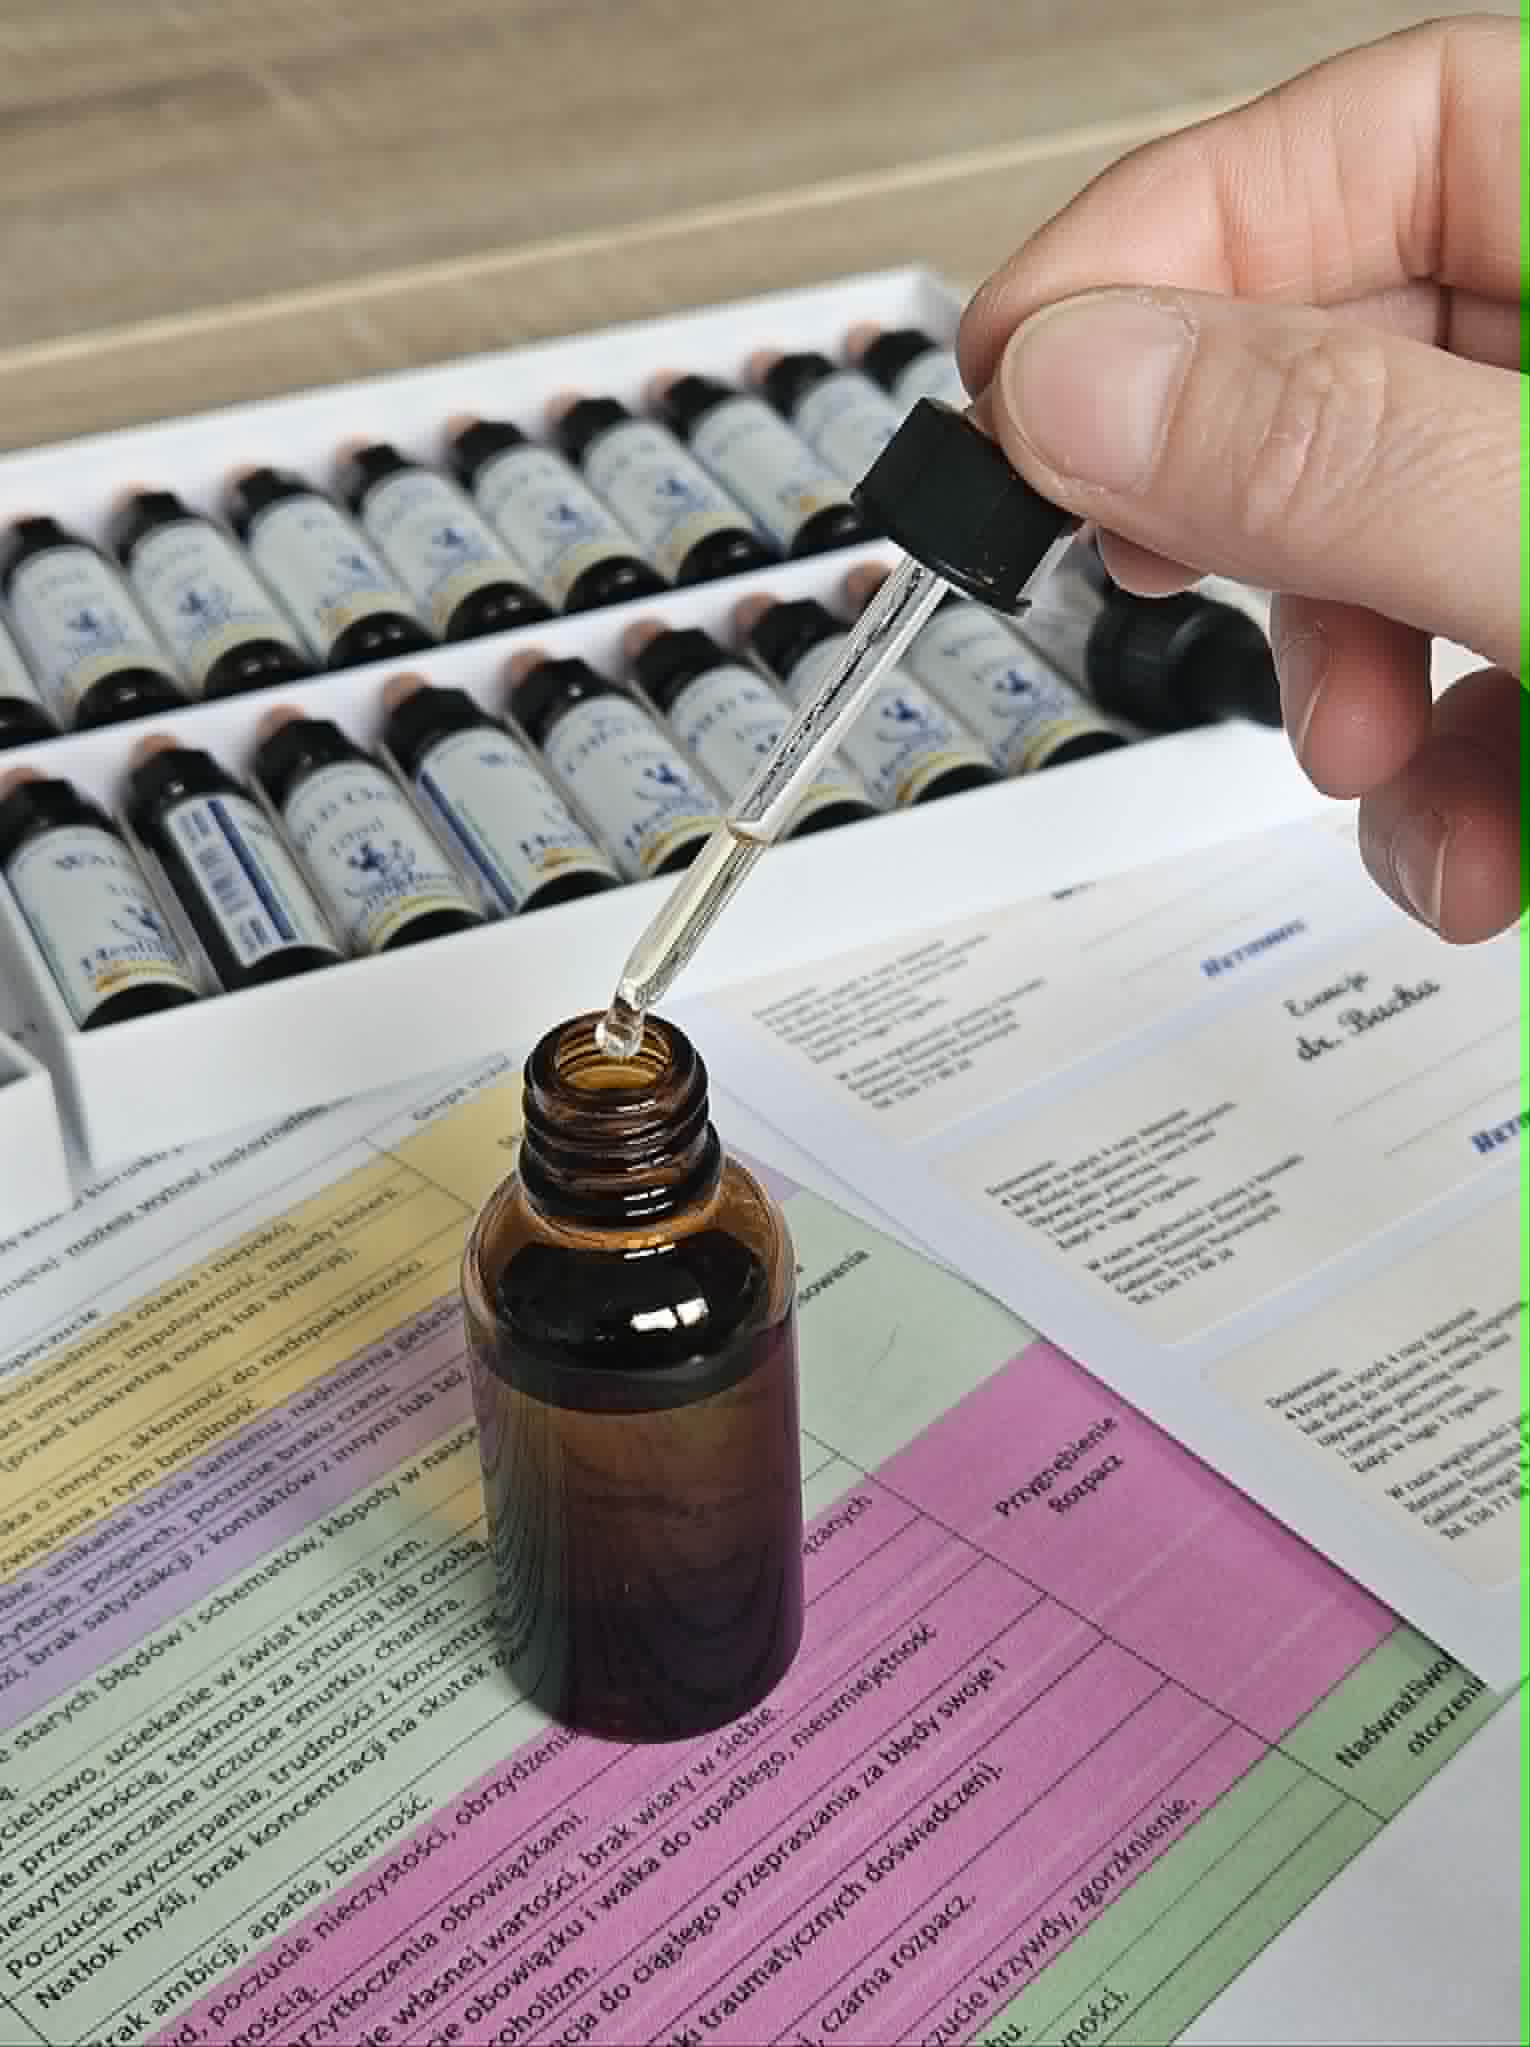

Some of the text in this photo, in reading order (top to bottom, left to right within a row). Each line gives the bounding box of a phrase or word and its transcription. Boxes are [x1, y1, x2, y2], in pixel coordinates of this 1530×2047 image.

[995, 1418, 1116, 1517] Przygnębienie
[1048, 1455, 1123, 1513] Rozpacz
[14, 1691, 98, 1750] starych
[96, 1630, 182, 1691] błędów
[182, 1620, 197, 1633] i
[198, 1537, 325, 1624] schematów,
[319, 1483, 401, 1537] kłopoty
[399, 1467, 421, 1484] w
[25, 1629, 80, 1666] brak
[193, 1543, 209, 1557] z
[208, 1469, 317, 1544] kontaktów
[106, 1687, 213, 1765] uciekanie
[215, 1667, 237, 1687] w
[239, 1624, 299, 1671] świat
[297, 1567, 385, 1627] fantazji,
[20, 1772, 168, 1876] przeszłością,
[166, 1695, 266, 1766] tęsknota
[267, 1674, 294, 1696] za
[295, 1610, 385, 1675] sytuacją
[379, 1584, 419, 1611] lub
[200, 1727, 284, 1790] uczucie
[285, 1664, 375, 1727] smutku,
[375, 1587, 470, 1659] chandra.
[1336, 1655, 1454, 1767] Nadwrażliwo
[6, 1897, 117, 1980] Poczucie
[118, 1789, 271, 1896] wyczerpania,
[269, 1702, 375, 1784] trudności
[375, 1691, 392, 1706] z
[35, 1663, 491, 2008] Natłok myśli, brak koncentracji na skutek
[208, 1938, 311, 2026] poczucie
[314, 1830, 456, 1939] nieczystości,
[292, 1815, 587, 2045] rzytłoczenia obowiązkami.
[392, 1708, 783, 2025] własnej wartości, brak wiary w siebie.
[464, 1920, 584, 2024] obowiązku
[579, 1905, 597, 1922] i
[595, 1858, 661, 1910] walka
[660, 1831, 691, 1858] do
[692, 1751, 794, 1831] upadłego,
[599, 1983, 631, 2013] do
[633, 1905, 721, 1984] ciągłego
[722, 1786, 860, 1908] przepraszania
[858, 1764, 885, 1788] za
[878, 1715, 940, 1766] błędy
[937, 1668, 995, 1718] swoje
[105, 2013, 150, 2045] rak
[151, 1943, 248, 2016] ambicji,
[248, 1880, 330, 1940] apatia,
[699, 1883, 866, 2029] traumatycznych
[821, 1895, 976, 2033] czarna rozpacz.
[980, 1912, 1078, 1993] krzywdy,
